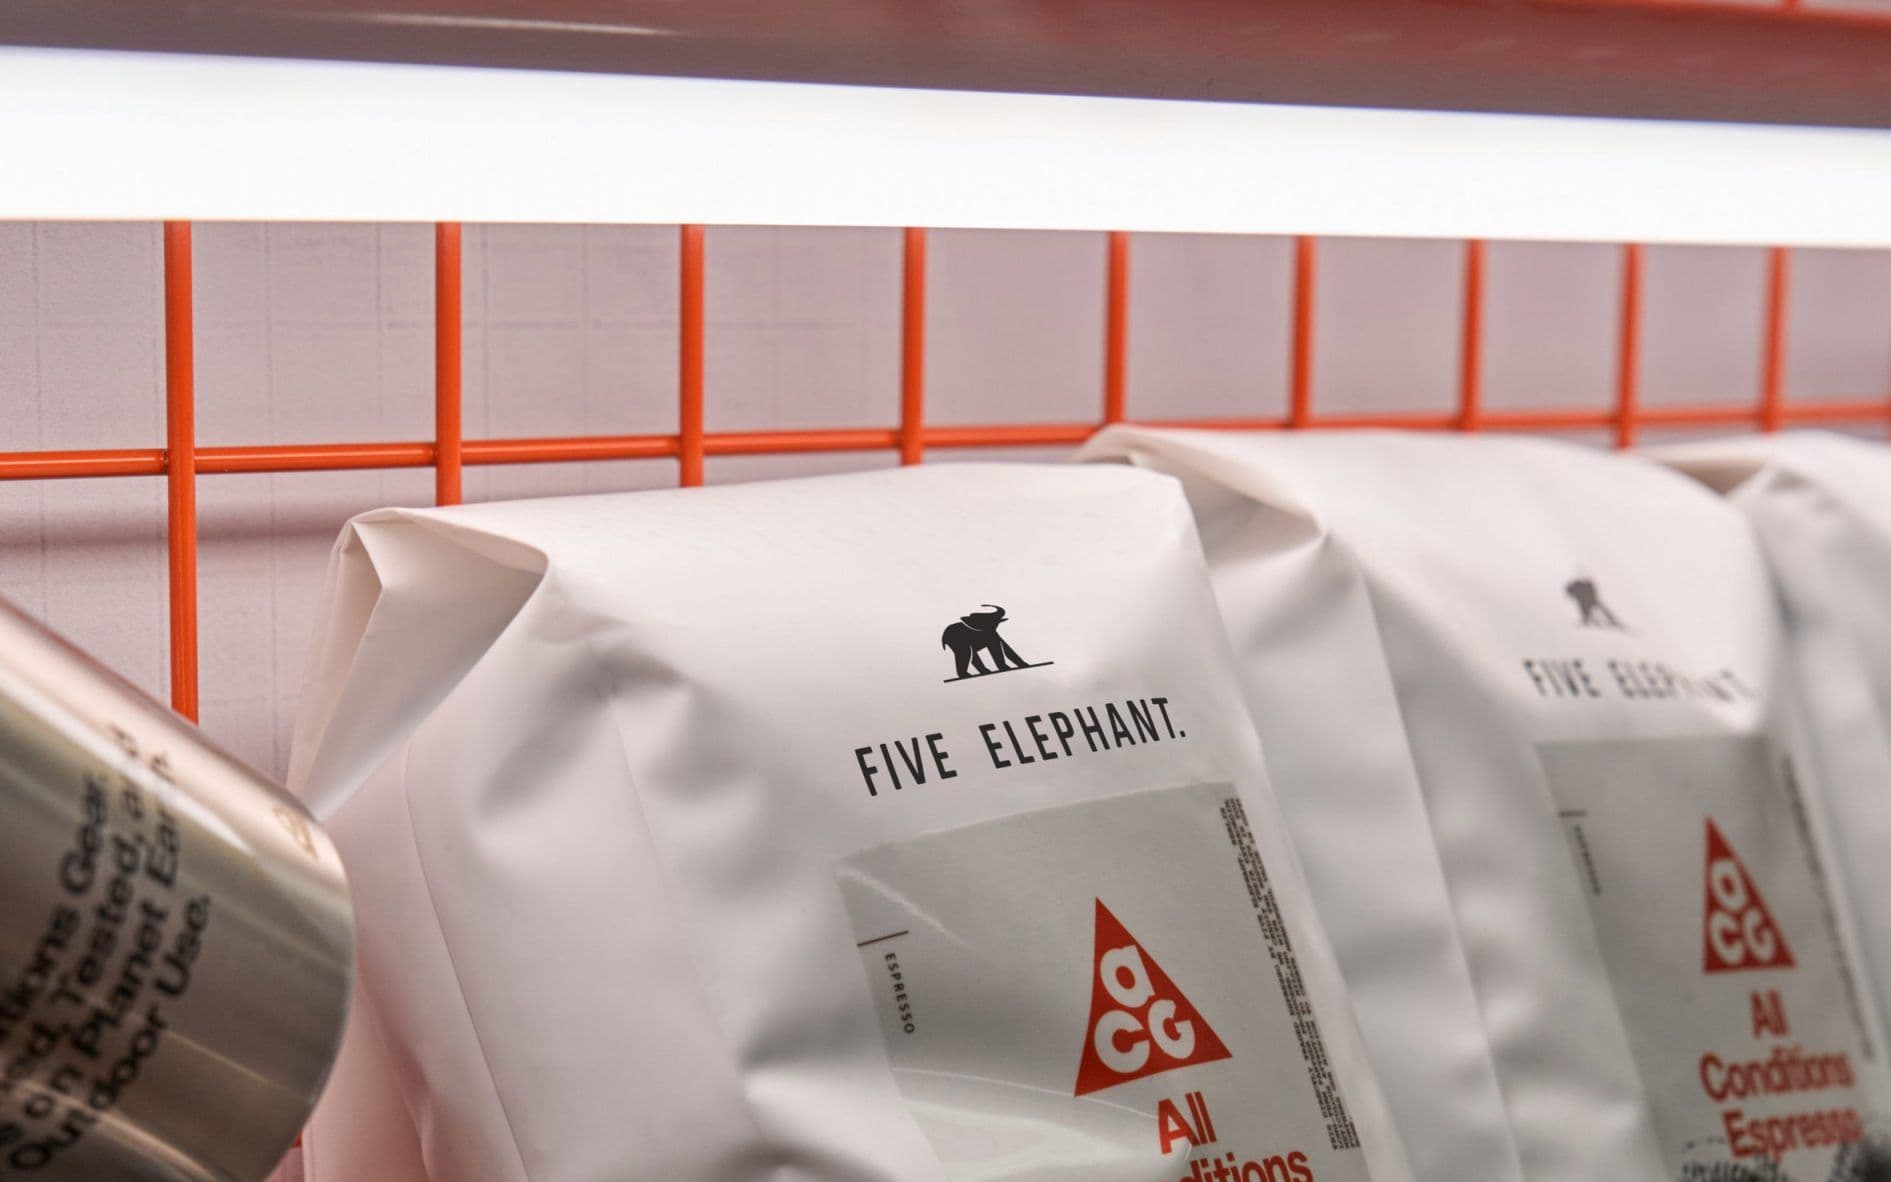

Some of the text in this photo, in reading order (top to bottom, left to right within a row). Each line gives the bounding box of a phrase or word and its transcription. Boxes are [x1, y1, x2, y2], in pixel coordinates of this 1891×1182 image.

[1523, 659, 1601, 698] FIVE
[854, 697, 1187, 797] FIVE ELEPHANT.
[884, 951, 915, 1035] ESPRESSO
[1751, 989, 1790, 1039] All
[1700, 1045, 1856, 1104] Conditions
[1157, 1090, 1218, 1154] All
[1721, 1108, 1865, 1167] Espresso
